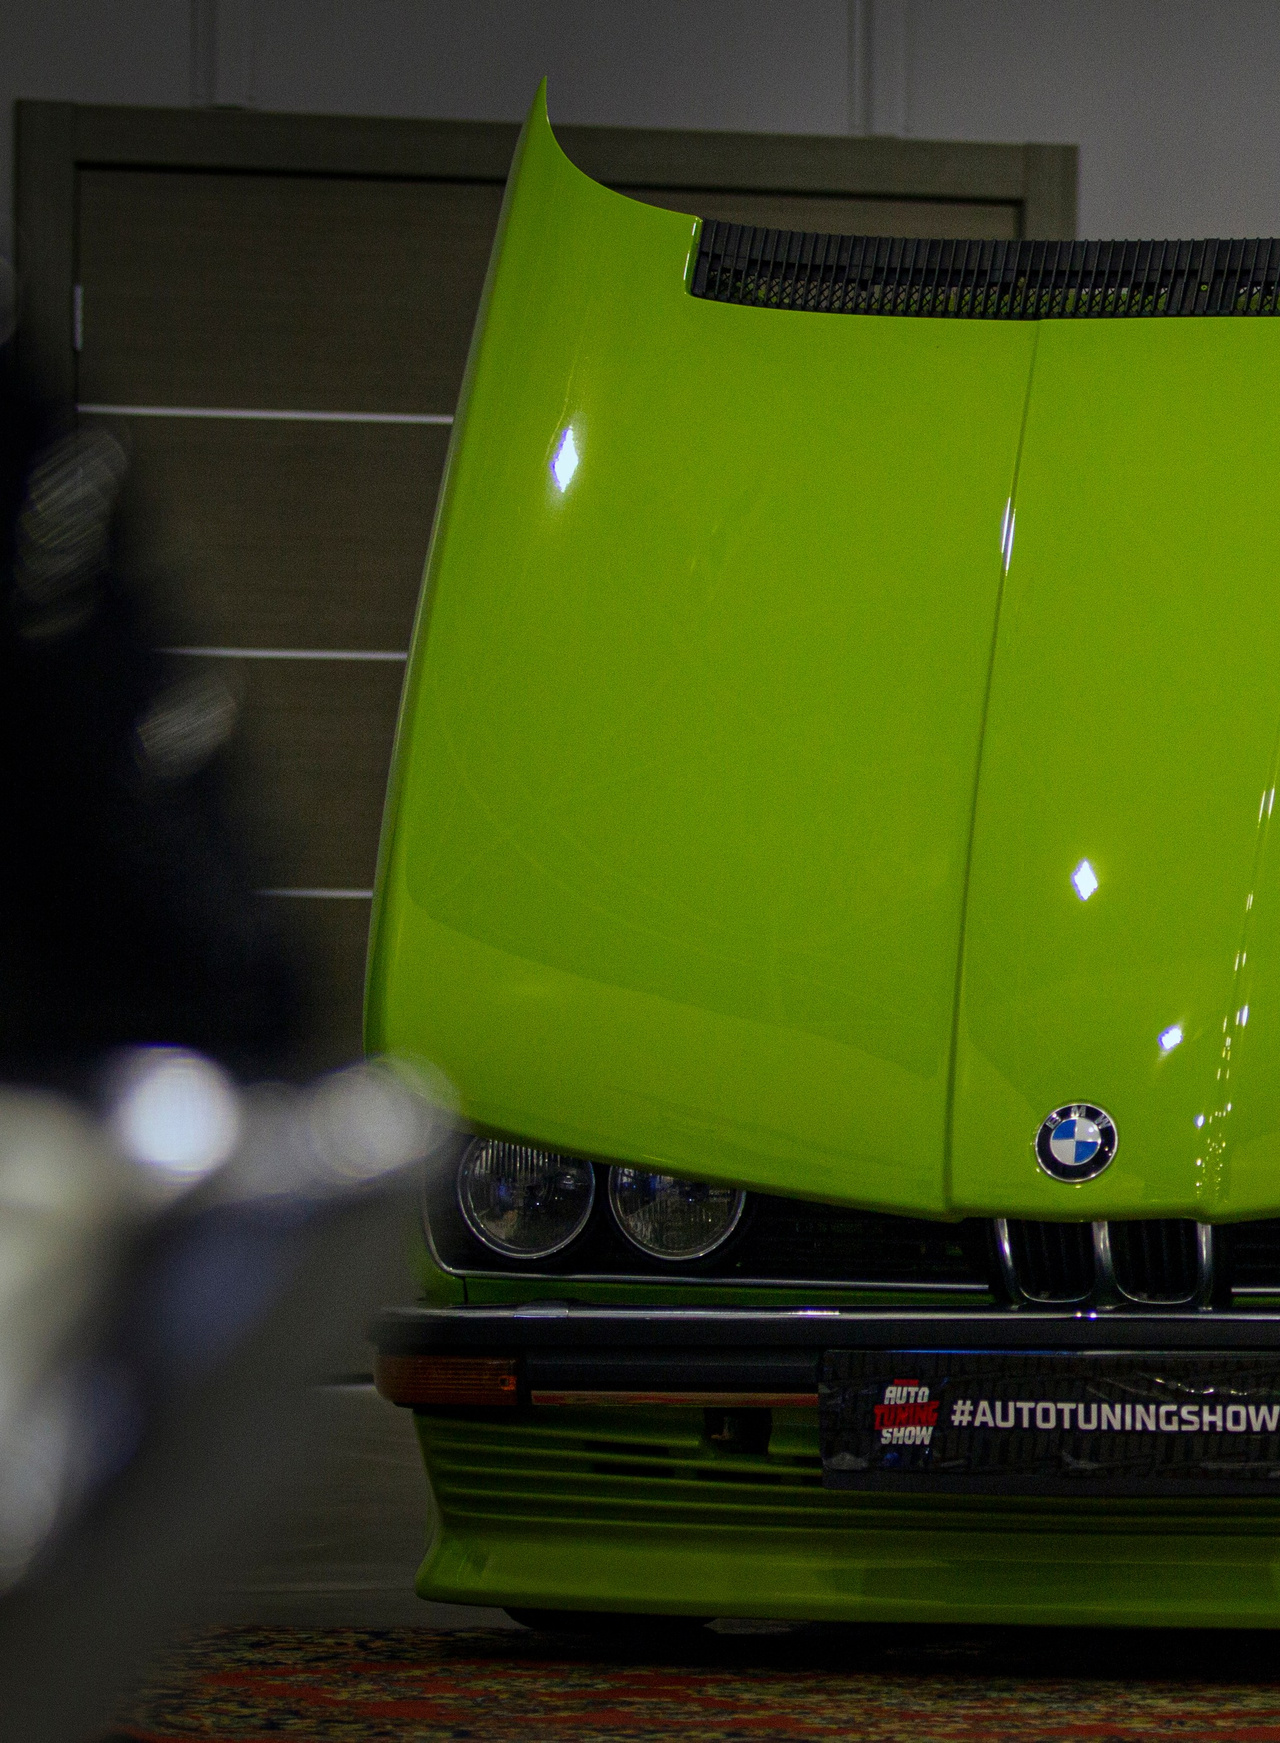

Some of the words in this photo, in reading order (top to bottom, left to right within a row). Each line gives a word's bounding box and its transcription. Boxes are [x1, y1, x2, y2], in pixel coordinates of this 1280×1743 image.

[1044, 1105, 1111, 1129] BMW
[884, 1386, 930, 1405] AUTO
[874, 1400, 939, 1430] TUNING
[951, 1400, 1280, 1431] #AUTOTUNINGSHOW
[881, 1426, 934, 1445] SHOW
